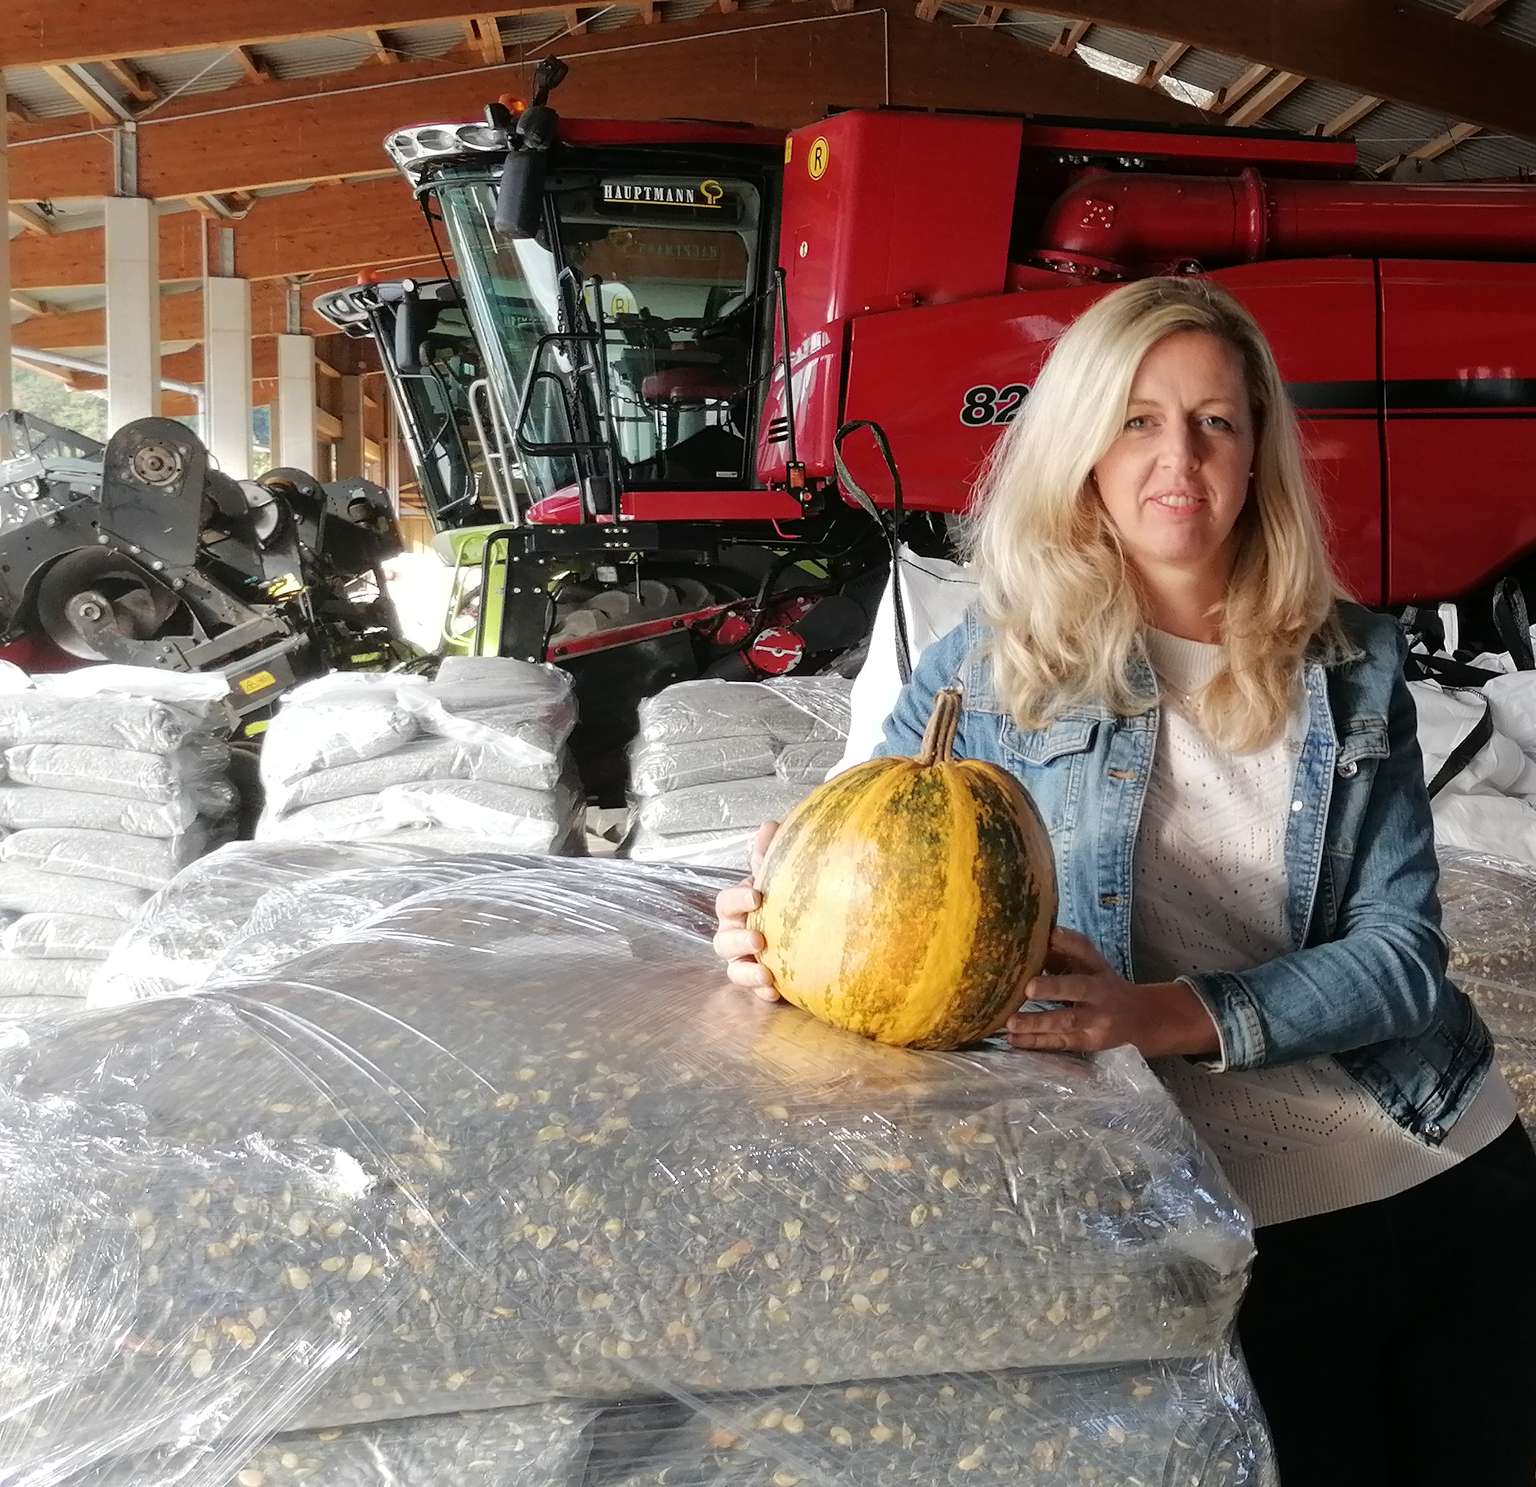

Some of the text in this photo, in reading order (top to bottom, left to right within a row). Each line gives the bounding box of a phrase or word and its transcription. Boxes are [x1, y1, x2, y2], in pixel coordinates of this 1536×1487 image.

[814, 146, 822, 171] R
[603, 184, 695, 203] HAUPTMANN
[960, 383, 1031, 427] 82
